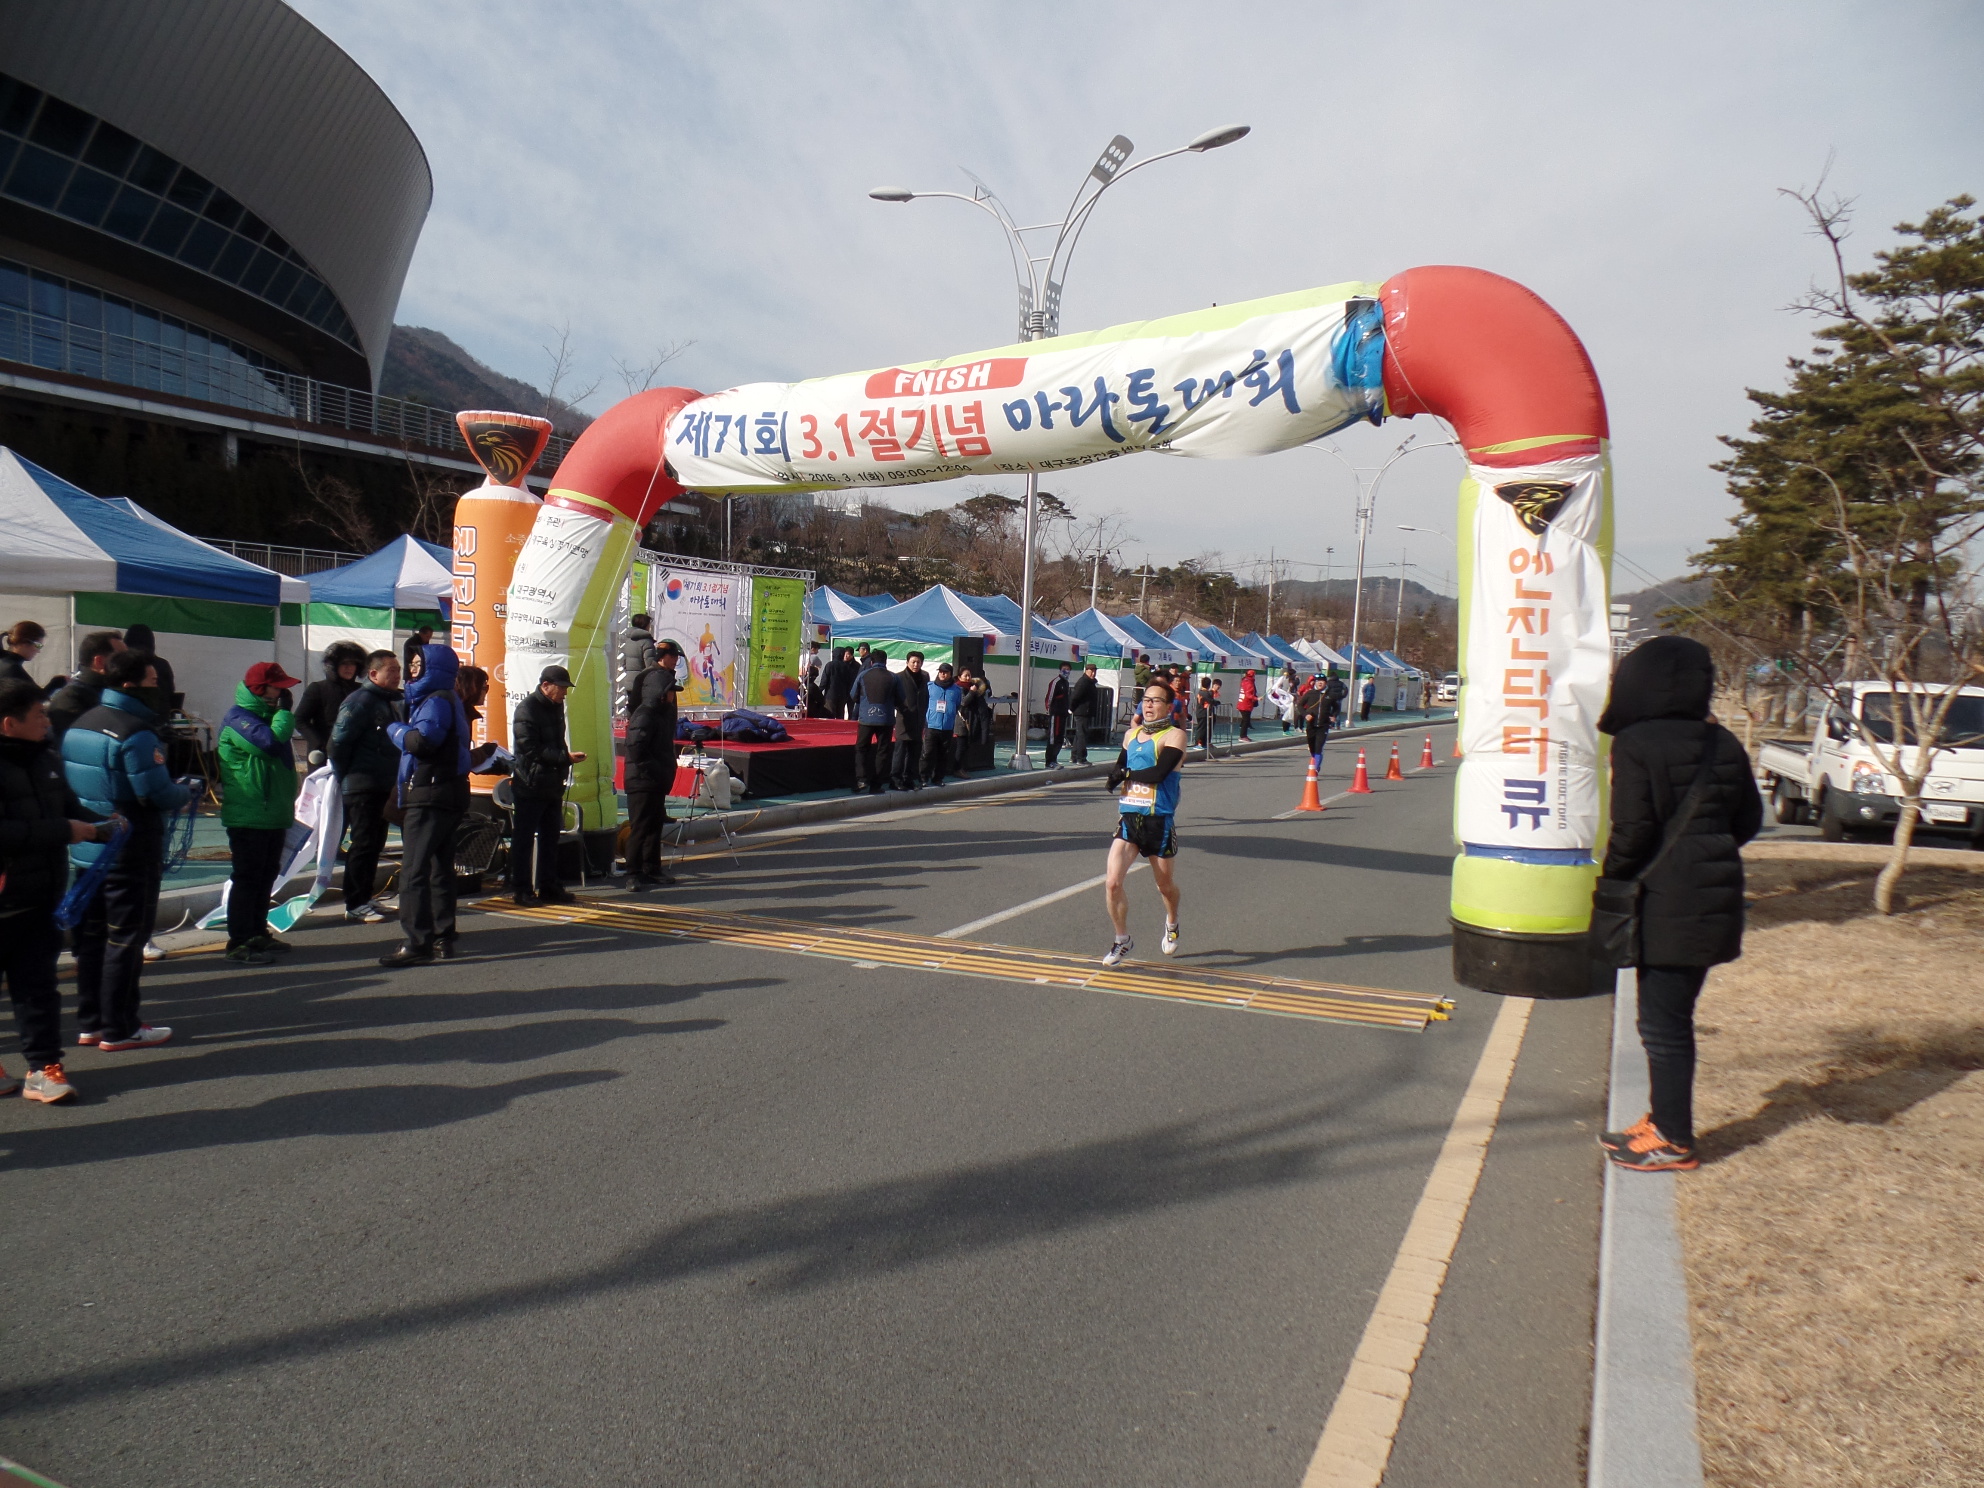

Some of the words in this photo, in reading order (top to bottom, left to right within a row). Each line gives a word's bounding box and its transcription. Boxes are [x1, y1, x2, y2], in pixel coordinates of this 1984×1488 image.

[675, 410, 792, 462] 제71회
[800, 400, 993, 462] 3.1절기념
[809, 472, 841, 483] 2016.
